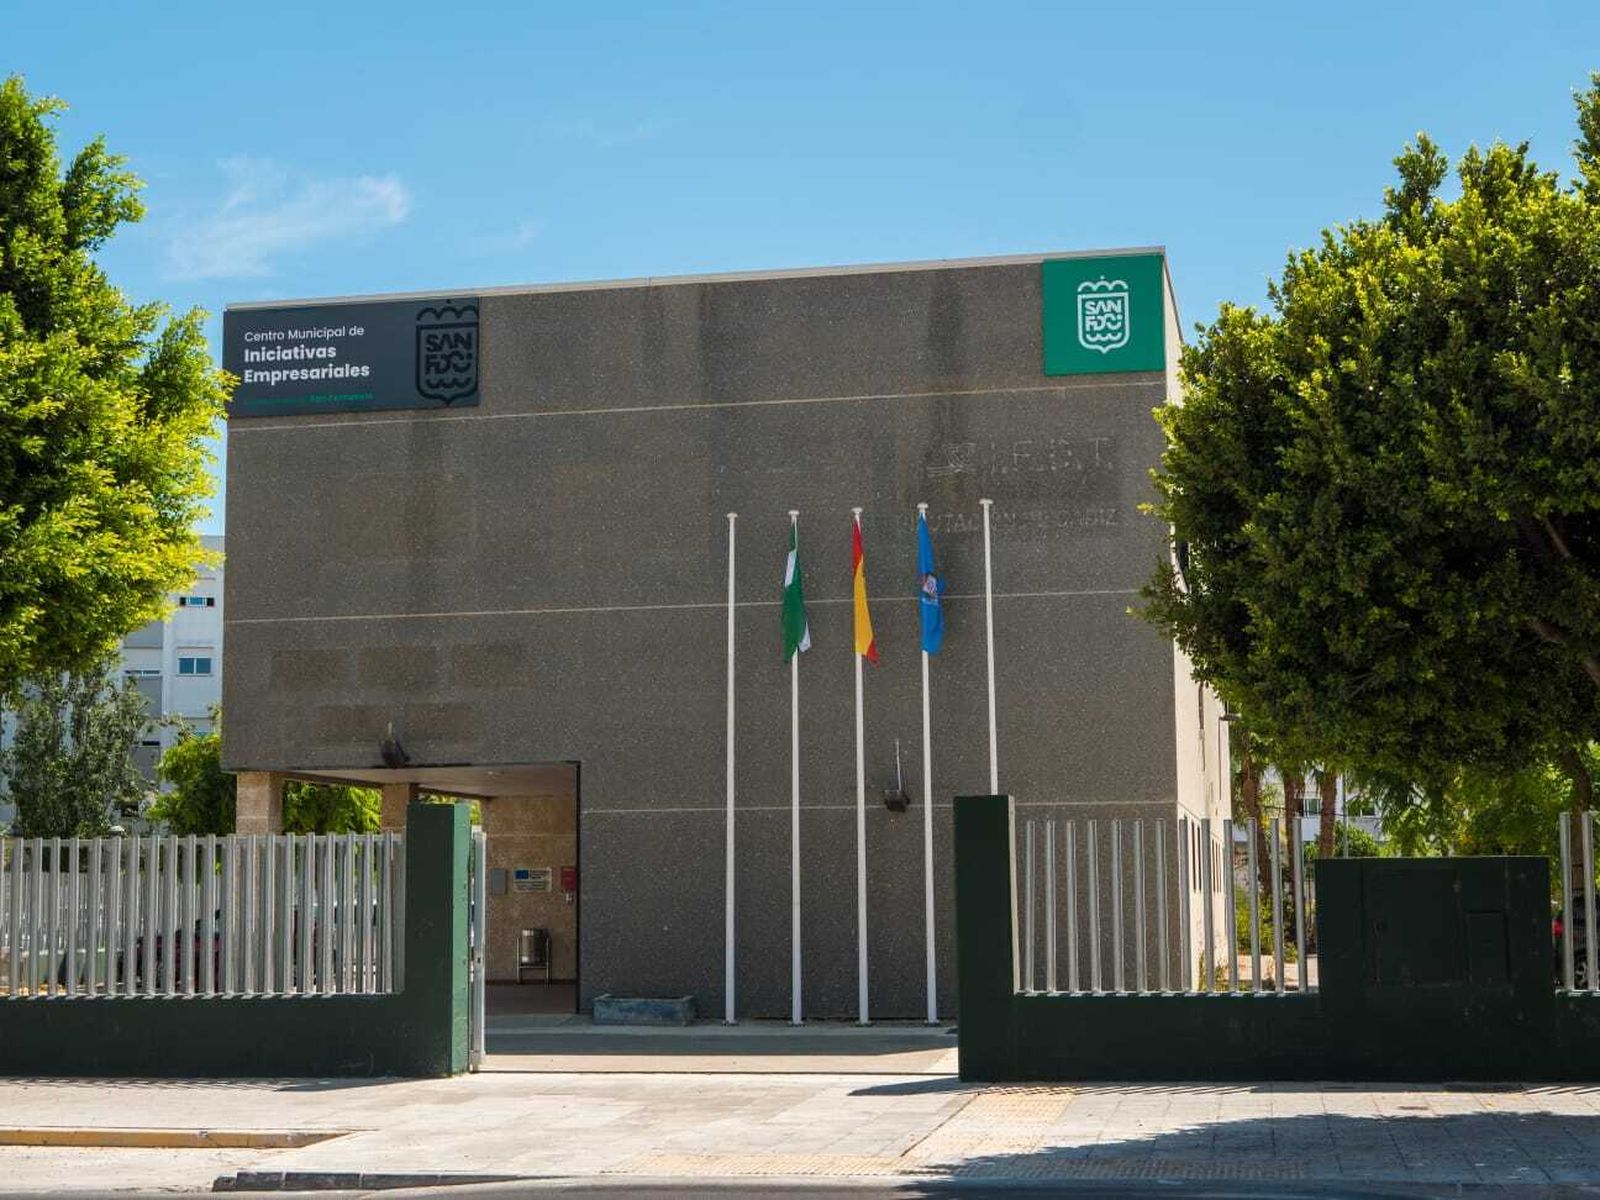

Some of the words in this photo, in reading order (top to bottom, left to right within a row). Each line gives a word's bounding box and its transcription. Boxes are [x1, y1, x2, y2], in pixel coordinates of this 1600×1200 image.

[1085, 300, 1121, 315] SAN
[244, 330, 285, 342] Centro
[288, 326, 345, 341] Municipal
[349, 325, 365, 337] de
[425, 332, 472, 354] SAN
[244, 344, 337, 363] Iniciativas
[244, 363, 370, 386] Empresariales
